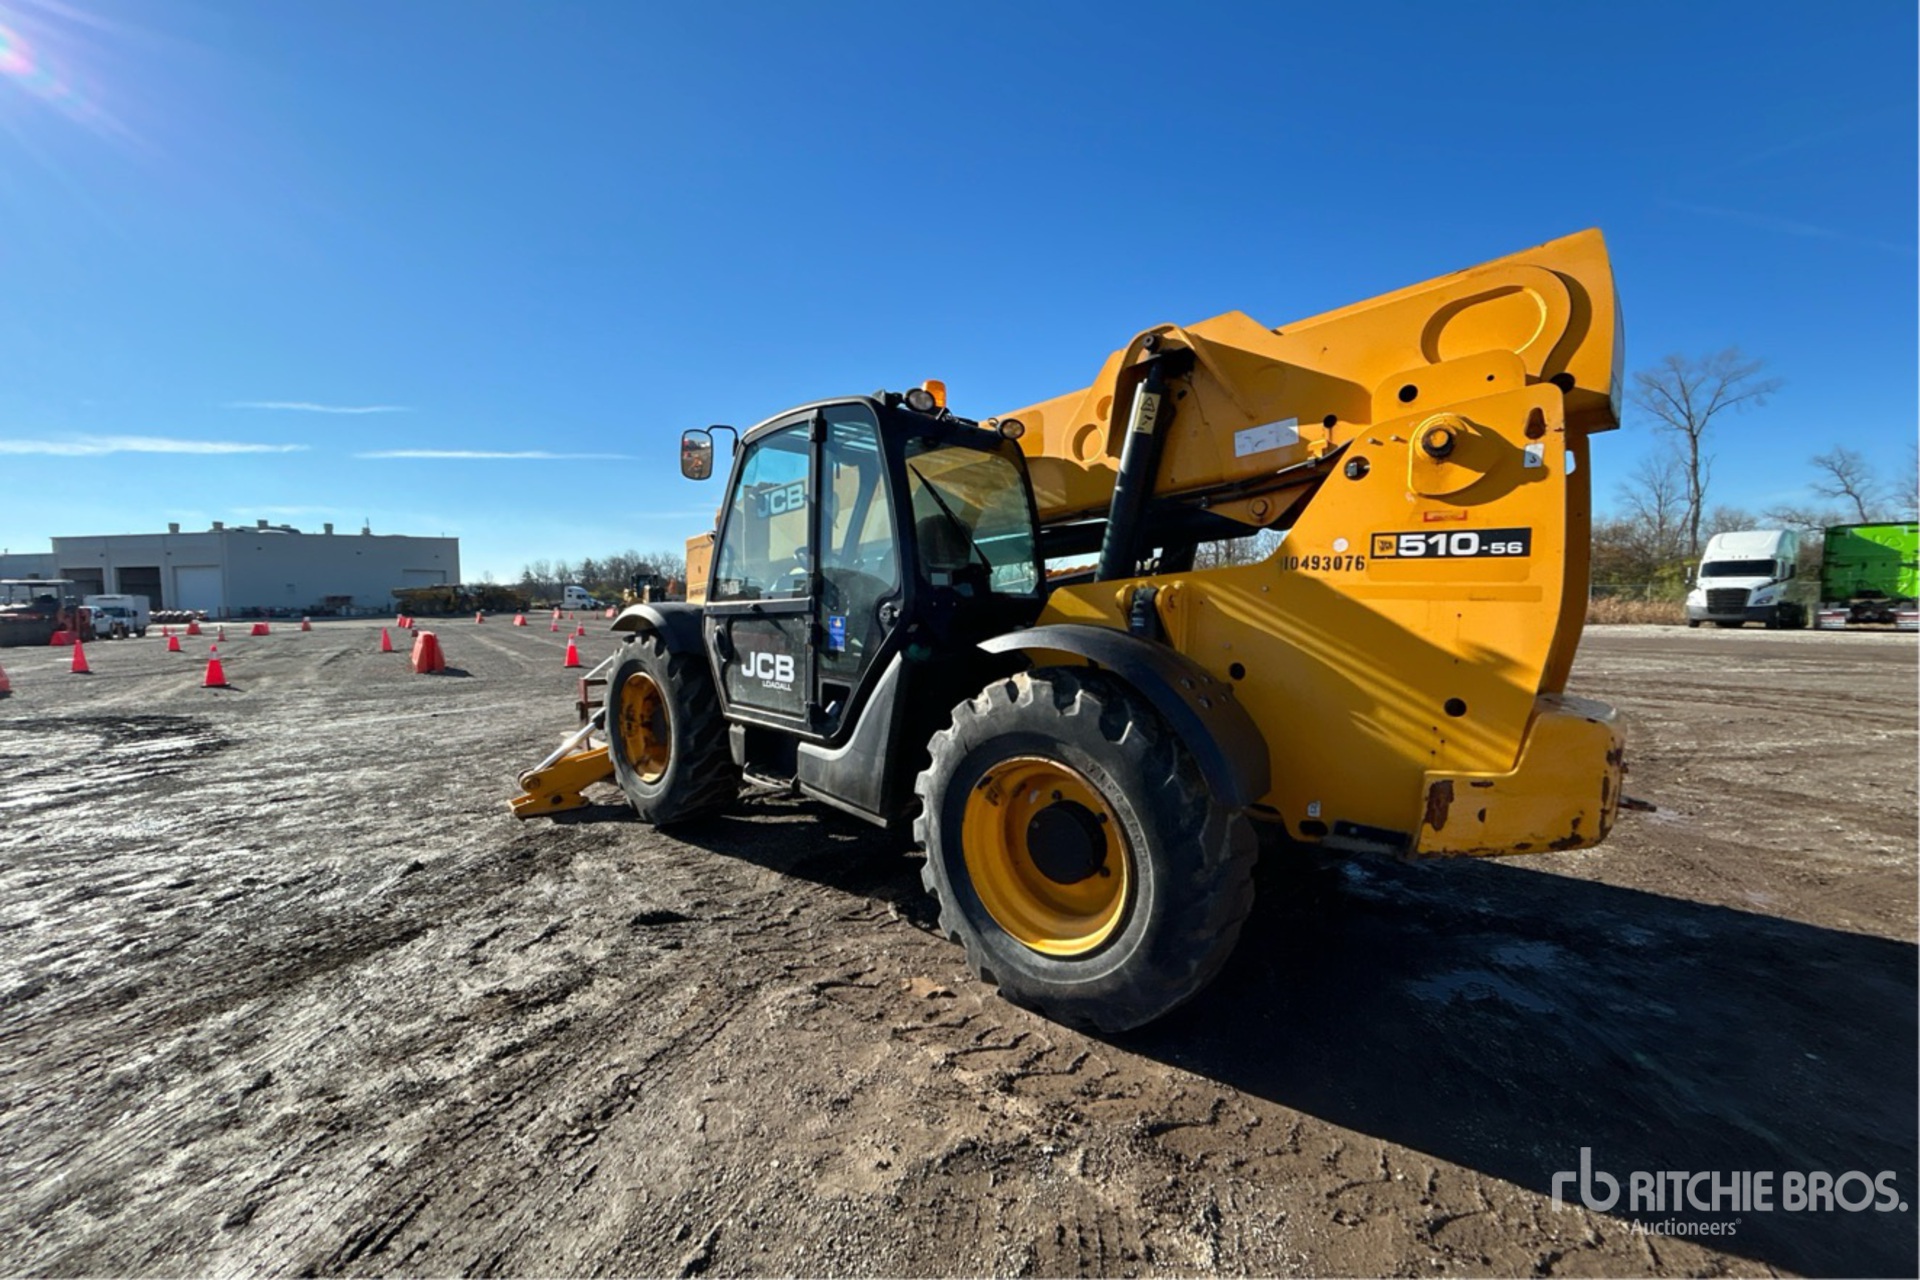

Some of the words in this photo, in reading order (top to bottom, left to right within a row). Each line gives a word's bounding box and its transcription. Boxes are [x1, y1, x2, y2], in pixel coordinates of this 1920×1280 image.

[757, 484, 805, 518] JCB
[1397, 532, 1523, 557] 510-56
[1283, 555, 1365, 572] 10493076
[741, 651, 795, 683] JCB
[761, 680, 792, 692] LOADALL
